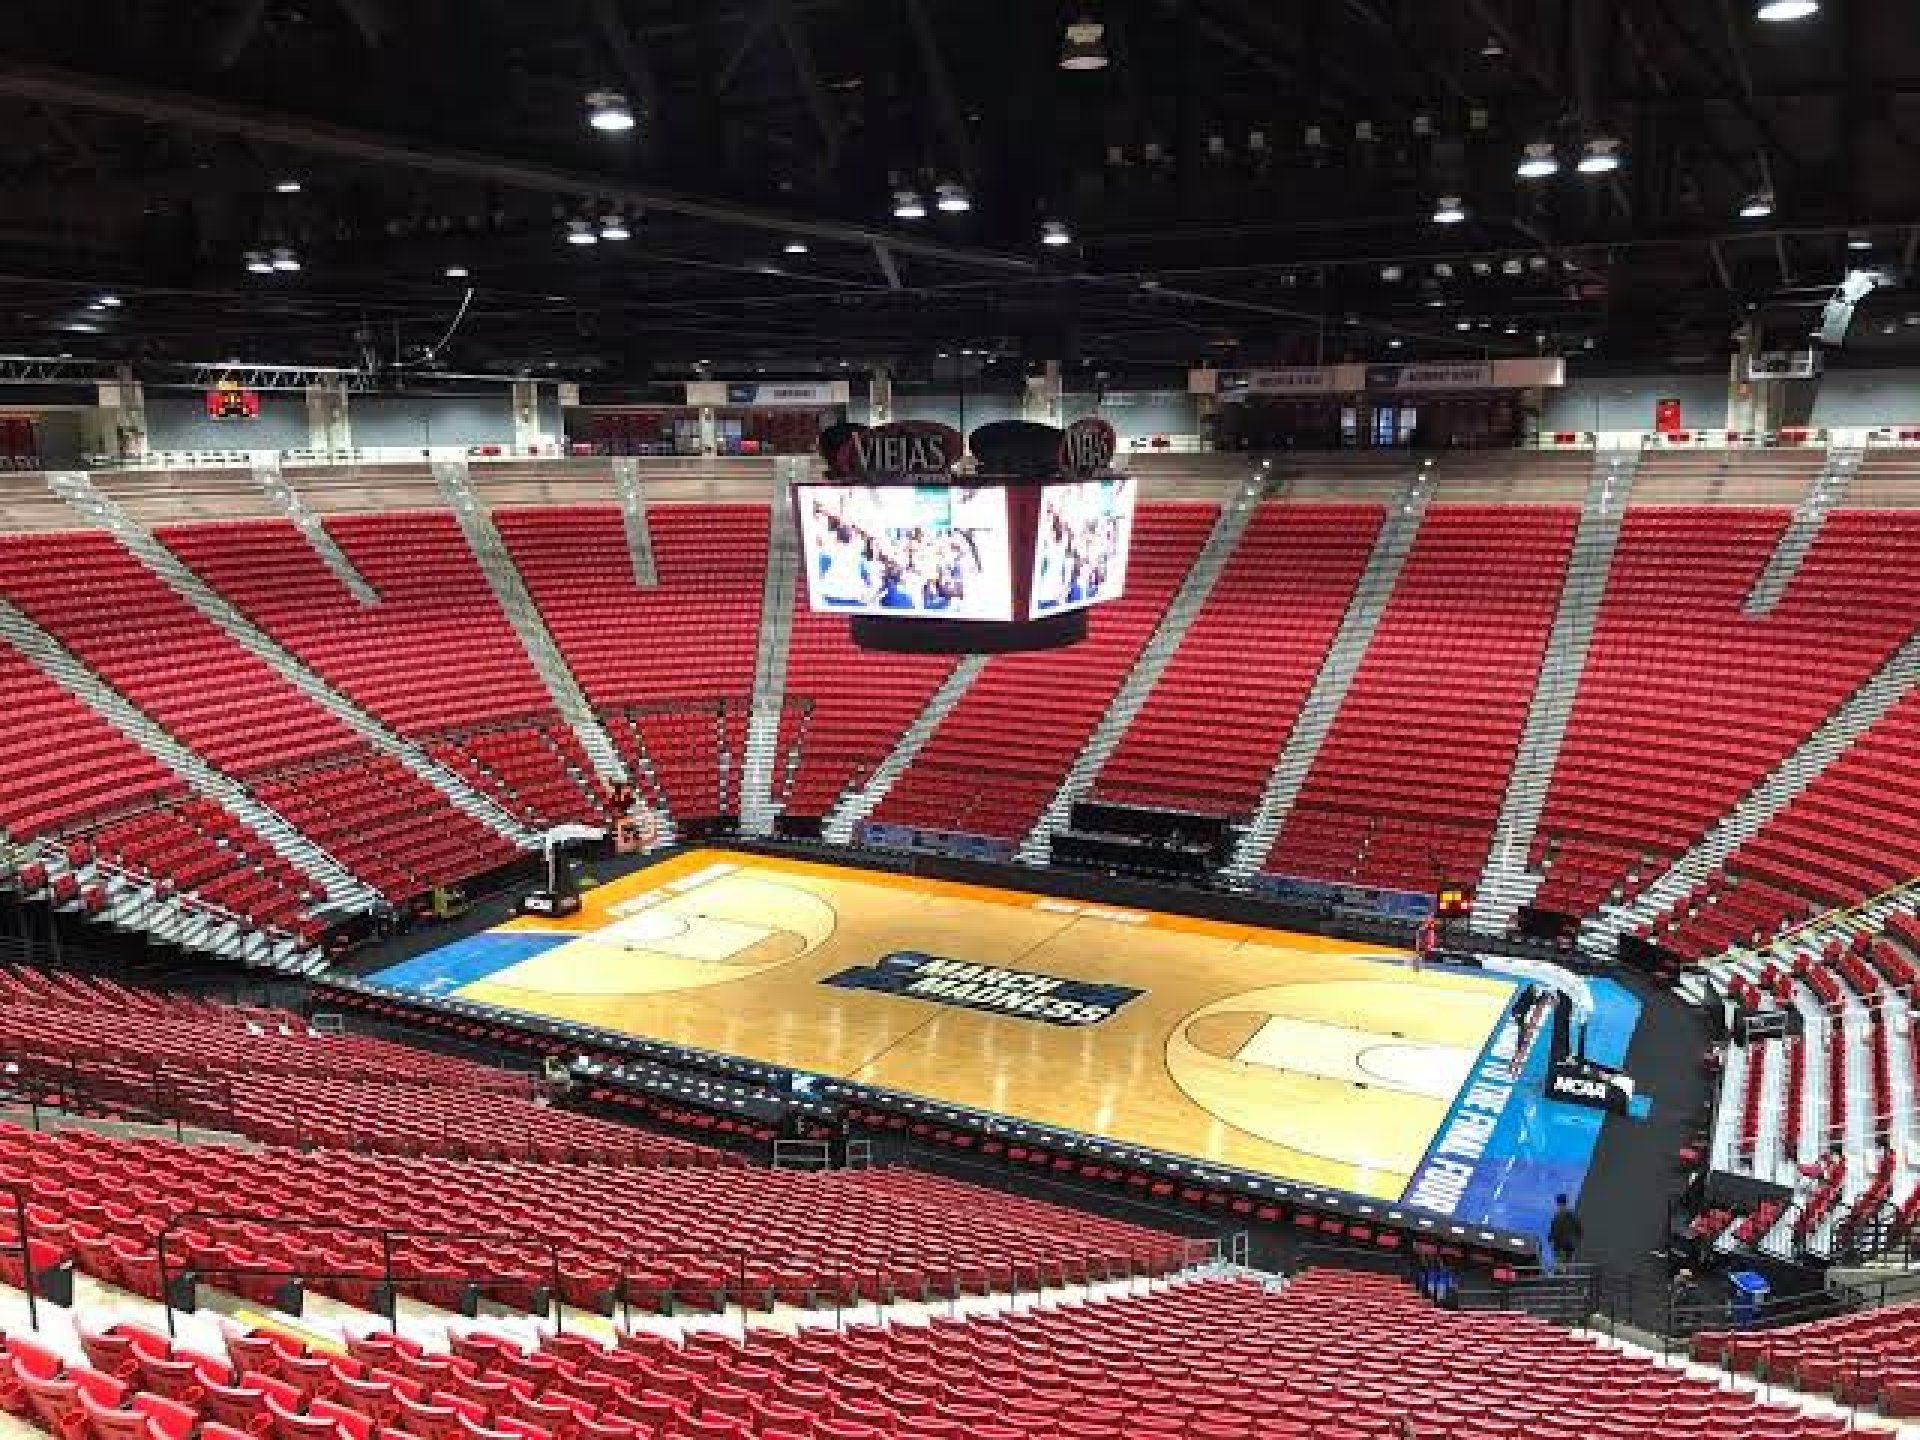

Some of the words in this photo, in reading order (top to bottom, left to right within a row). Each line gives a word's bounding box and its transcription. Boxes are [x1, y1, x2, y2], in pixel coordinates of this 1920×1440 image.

[852, 432, 946, 473] VIEJAS
[914, 957, 1064, 993] MARCH
[905, 976, 1111, 1021] MADNESS
[1553, 1076, 1606, 1099] NCAA
